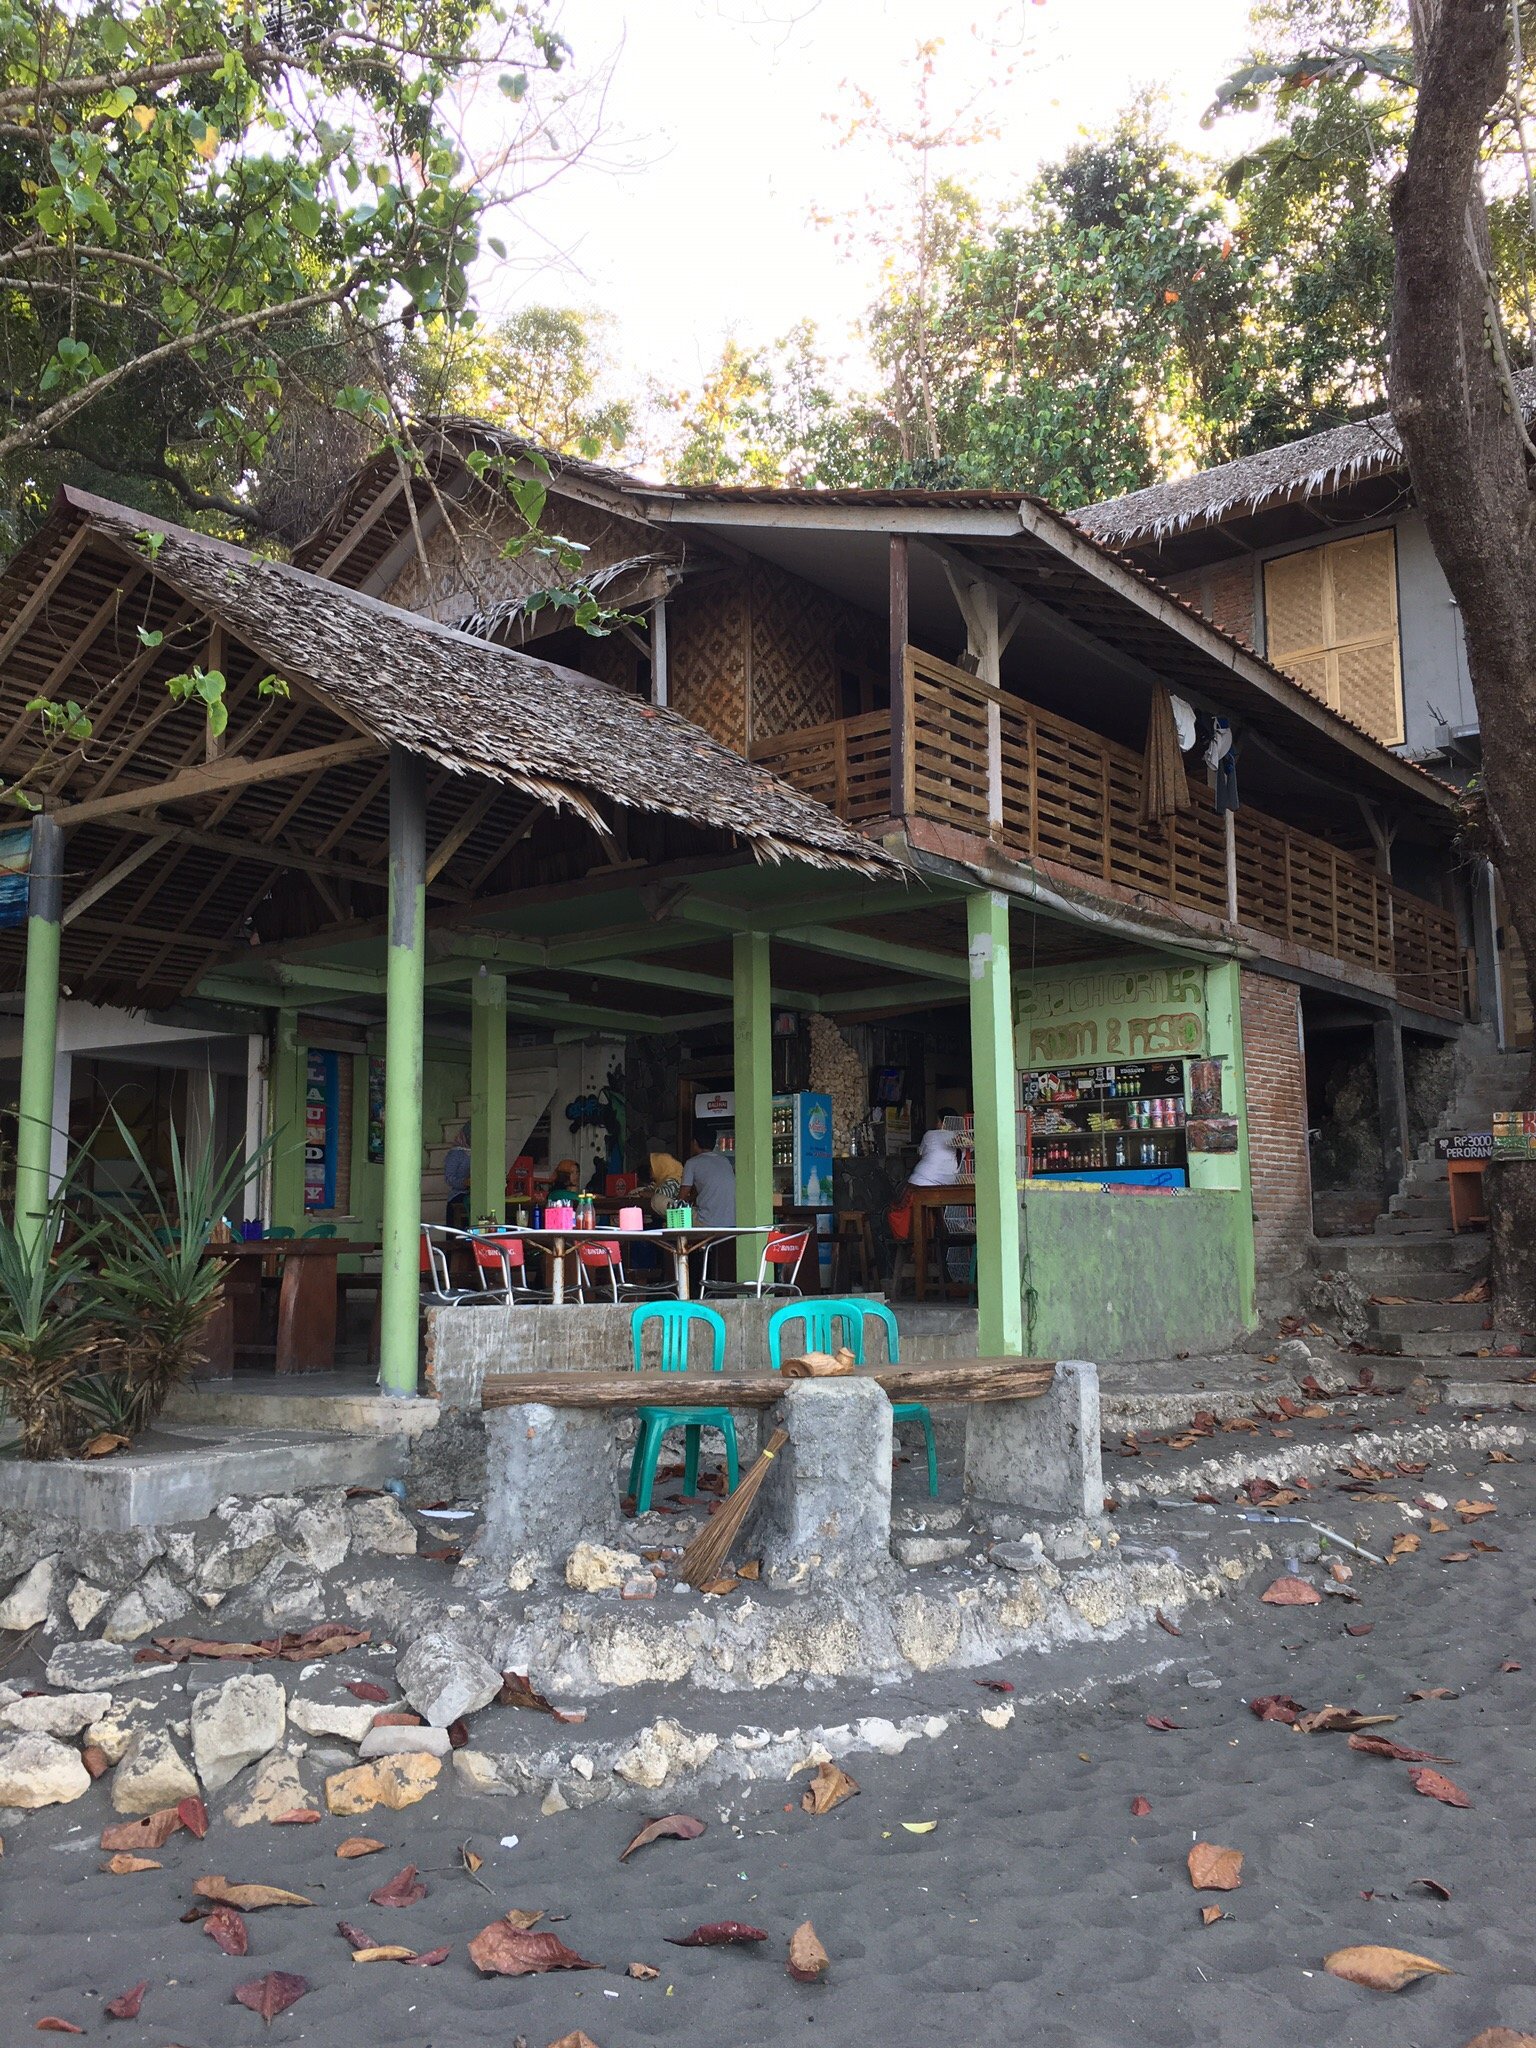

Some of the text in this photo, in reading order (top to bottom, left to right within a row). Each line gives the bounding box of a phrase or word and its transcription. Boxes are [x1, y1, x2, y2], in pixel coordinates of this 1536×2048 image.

[1015, 968, 1202, 1025] BEACH CORNER
[1030, 1019, 1098, 1061] ROOM
[1105, 1017, 1125, 1055] &
[305, 1067, 325, 1200] LAUNDRY
[1446, 1147, 1493, 1158] PER ORAN
